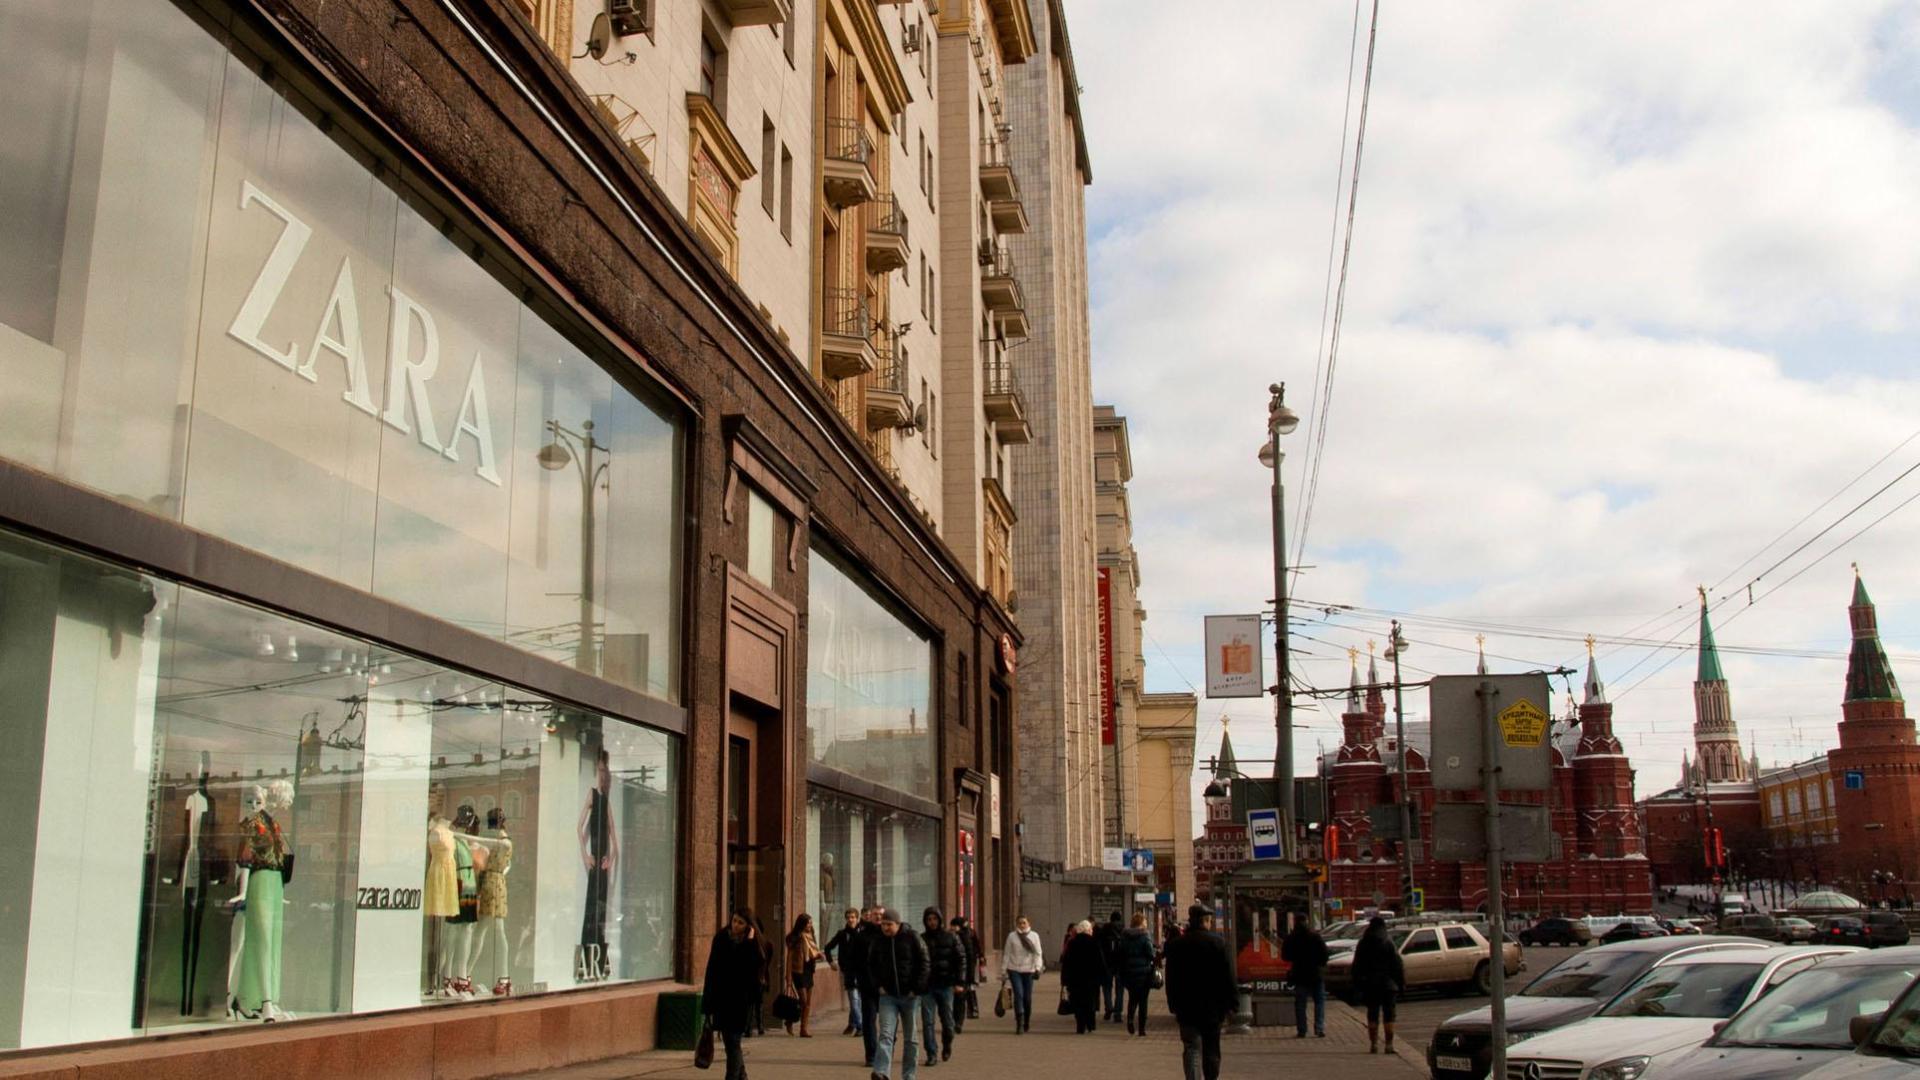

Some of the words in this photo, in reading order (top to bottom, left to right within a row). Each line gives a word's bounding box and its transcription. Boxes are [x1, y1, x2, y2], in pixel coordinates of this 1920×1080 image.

[225, 179, 501, 486] ZARA
[1099, 596, 1107, 660] МОСКВА
[1099, 664, 1109, 731] ГАЛЕРЕЯ
[356, 887, 421, 909] zara.com
[1256, 981, 1279, 990] РИВ
